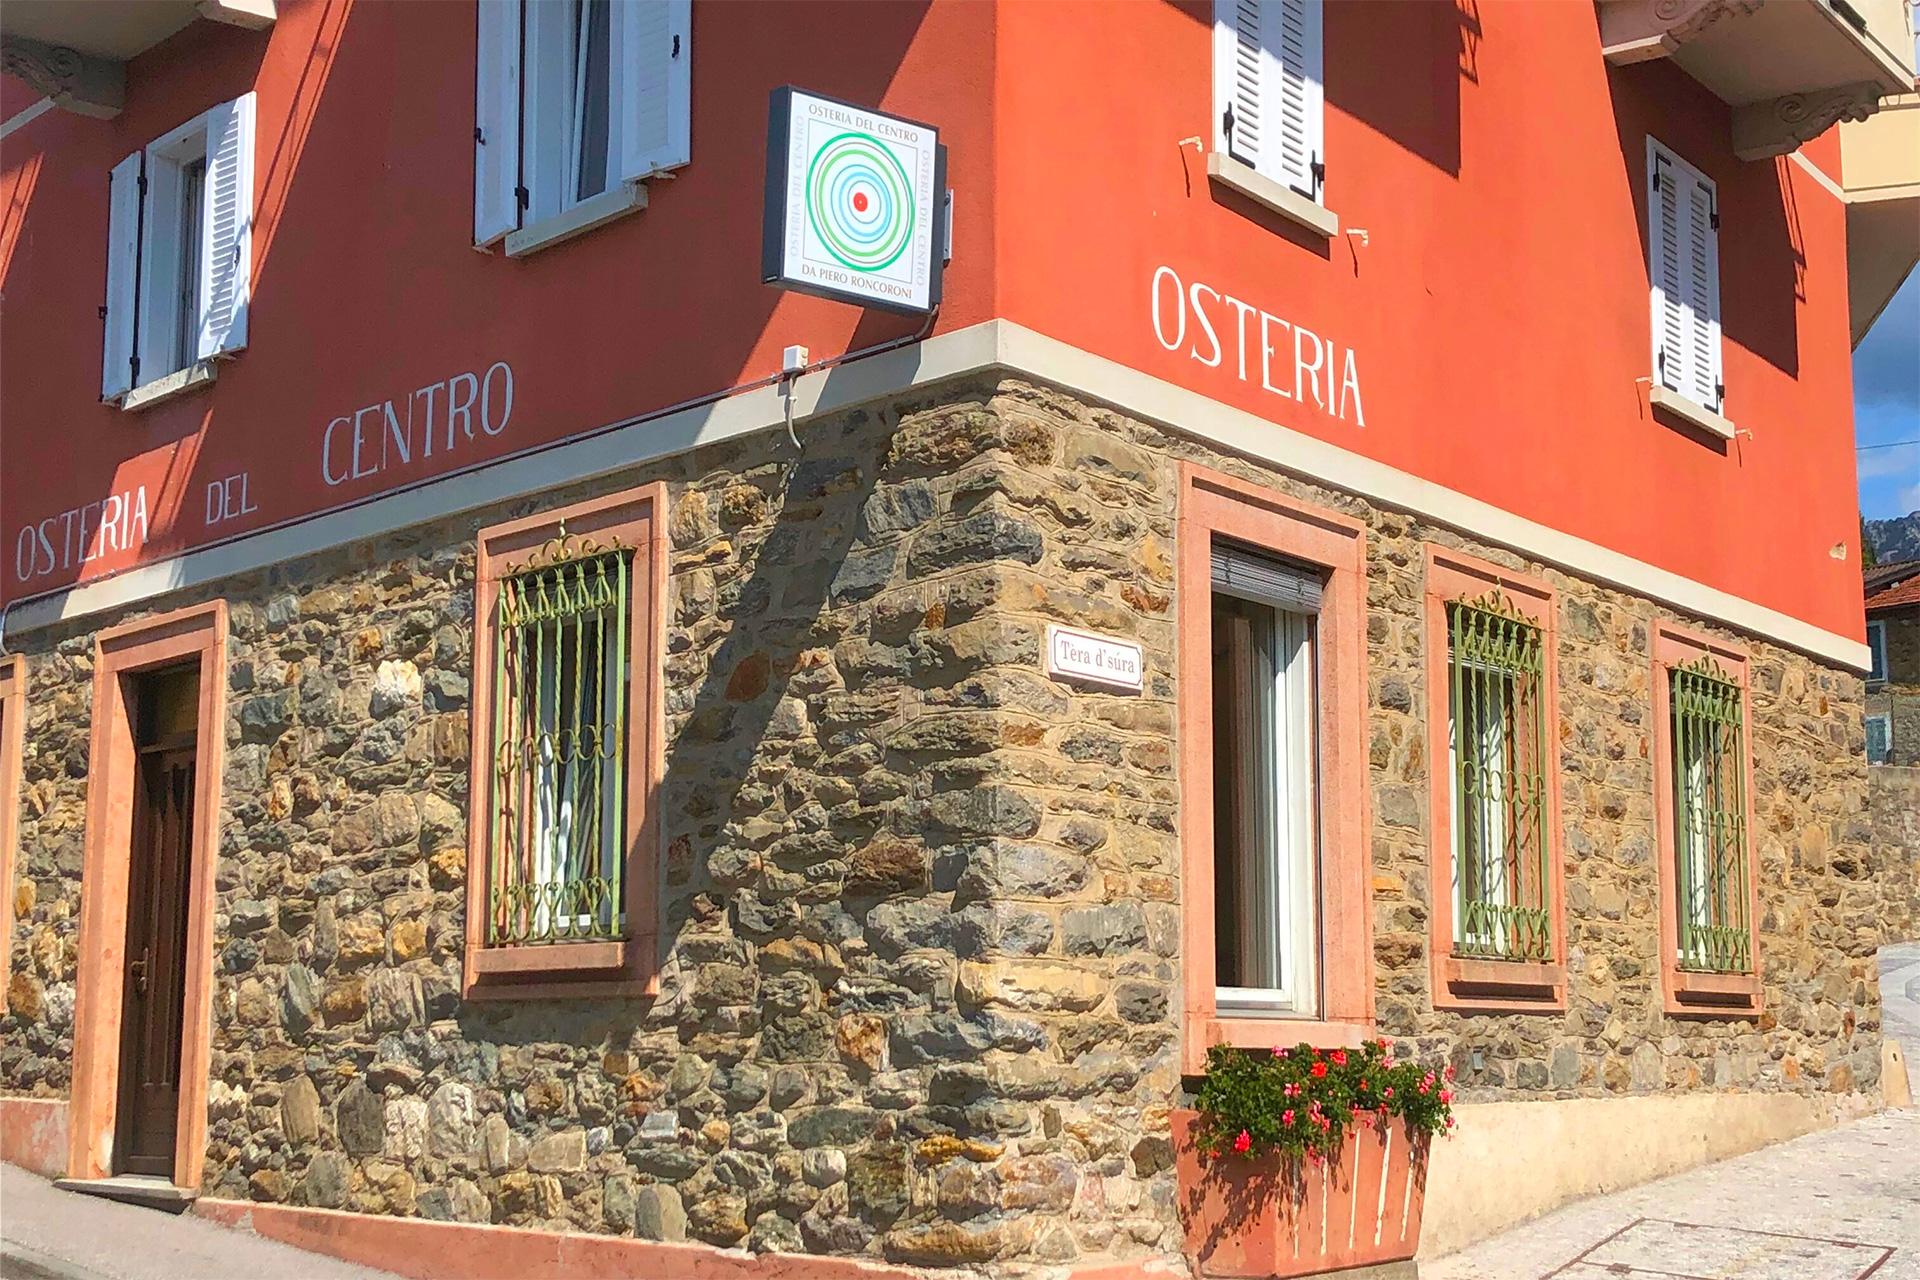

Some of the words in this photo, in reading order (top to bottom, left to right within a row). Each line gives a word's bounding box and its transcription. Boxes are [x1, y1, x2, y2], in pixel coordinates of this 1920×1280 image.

[808, 103, 852, 125] OSTERIA
[855, 116, 875, 131] DEL
[878, 123, 919, 143] CENTRO
[801, 263, 817, 277] DA
[819, 268, 848, 284] PIERO
[851, 276, 913, 299] RONCORONI
[1151, 265, 1366, 427] OSTERIA
[15, 485, 149, 583] OSTERIA
[205, 472, 258, 527] DEL
[321, 361, 515, 487] CENTRO
[1060, 640, 1091, 665] Tèra
